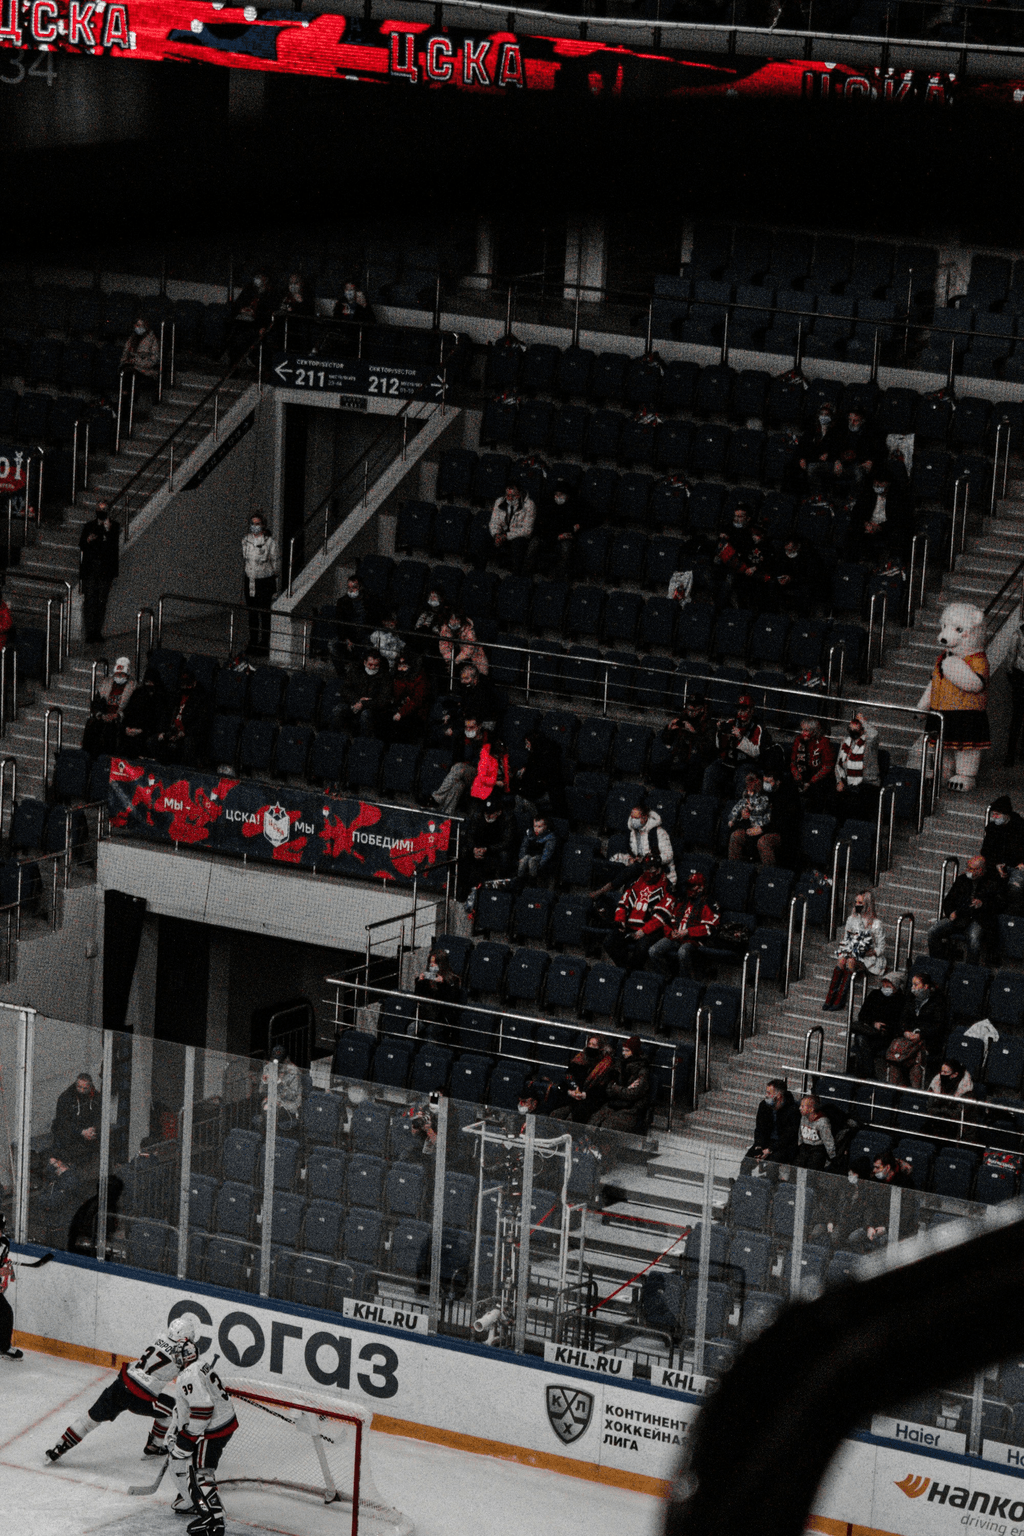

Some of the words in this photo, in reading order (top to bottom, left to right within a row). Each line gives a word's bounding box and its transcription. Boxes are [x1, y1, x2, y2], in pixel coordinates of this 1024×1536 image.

[391, 31, 526, 88] ЦСКА
[294, 368, 325, 388] 211
[367, 375, 400, 395] 212
[164, 797, 184, 811] МЫ
[225, 808, 261, 826] ЦСКА!
[294, 821, 315, 835] МЫ
[351, 831, 414, 854] ПОБЕДИМ!
[352, 1302, 419, 1331] KHL.RU
[135, 1346, 172, 1376] 37
[554, 1346, 623, 1375] KHL.RU
[182, 1383, 193, 1396] 39
[209, 1371, 230, 1401] 3
[605, 1404, 688, 1432] КОНТИНЕНТ
[603, 1434, 639, 1452] ЛИГА
[896, 1423, 941, 1447] Haier
[960, 1514, 1007, 1536] driving
